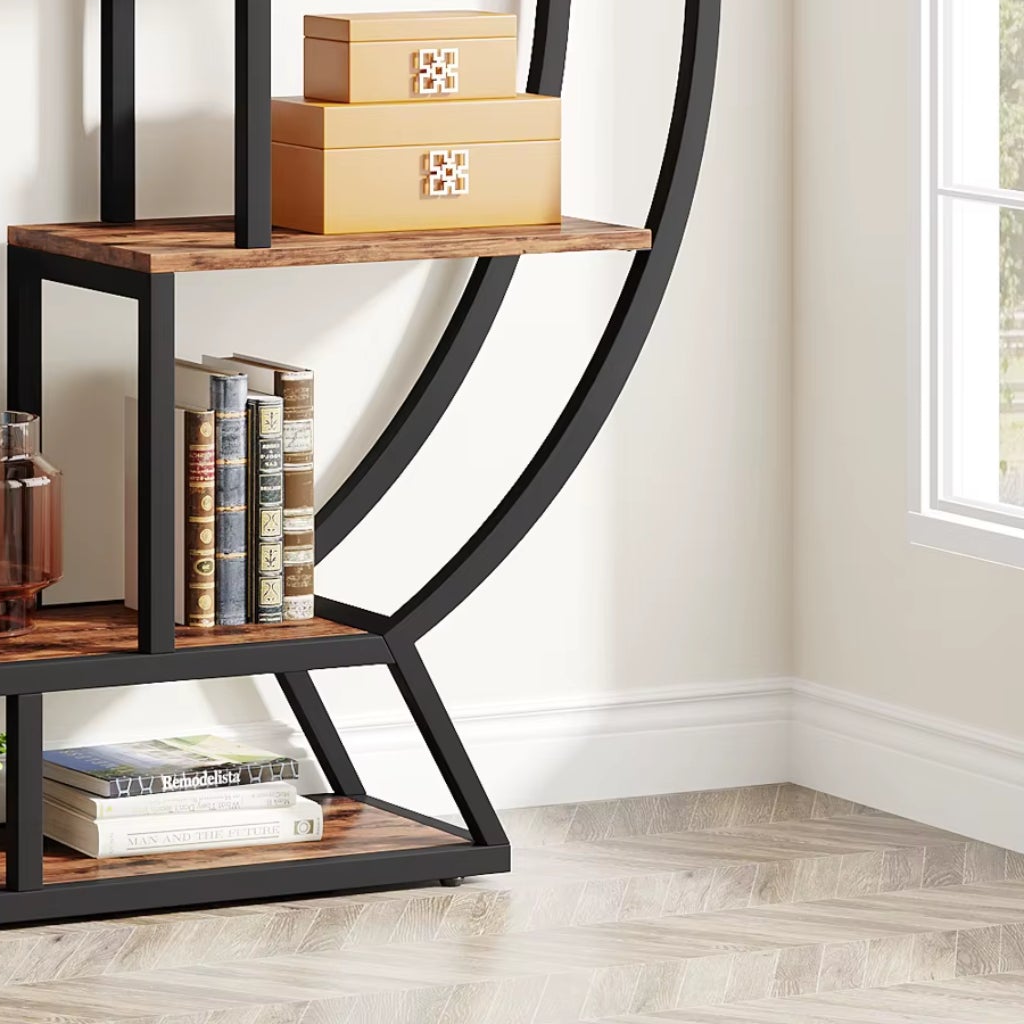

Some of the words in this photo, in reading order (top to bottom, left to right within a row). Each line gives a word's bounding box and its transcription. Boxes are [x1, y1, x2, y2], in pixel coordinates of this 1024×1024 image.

[162, 769, 240, 791] Remodelista
[128, 836, 158, 847] MAN
[160, 833, 192, 844] AND
[196, 830, 225, 841] THE
[228, 825, 280, 838] FUTURE
